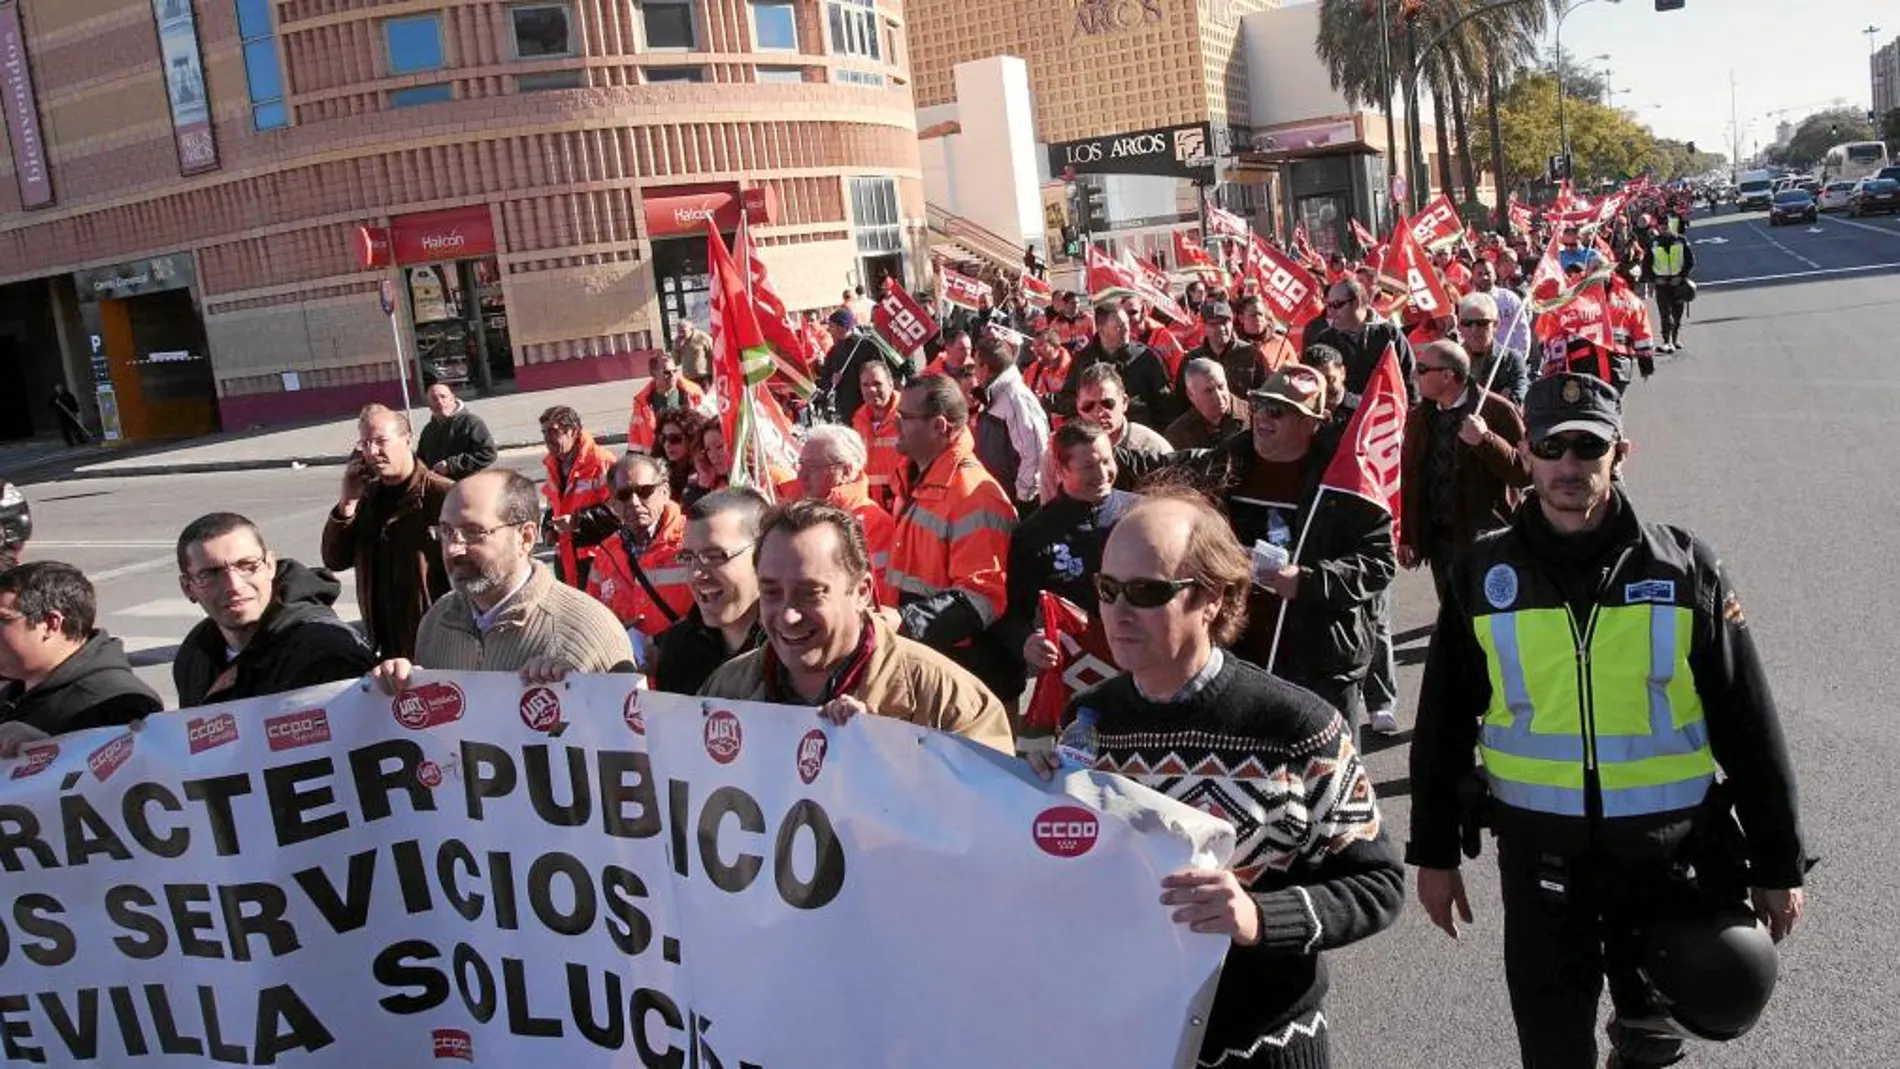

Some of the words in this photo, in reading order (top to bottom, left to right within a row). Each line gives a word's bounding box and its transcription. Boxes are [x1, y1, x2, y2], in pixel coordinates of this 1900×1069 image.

[1066, 142, 1101, 164] LOS
[1110, 133, 1166, 158] ARCOS
[421, 226, 465, 250] Halcón
[521, 690, 558, 722] UGT
[268, 719, 312, 738] CCOO
[708, 718, 738, 741] UGT
[460, 721, 845, 910] PÚBICO
[1037, 821, 1096, 838] CCOO
[104, 838, 681, 965] SERVICIOS.
